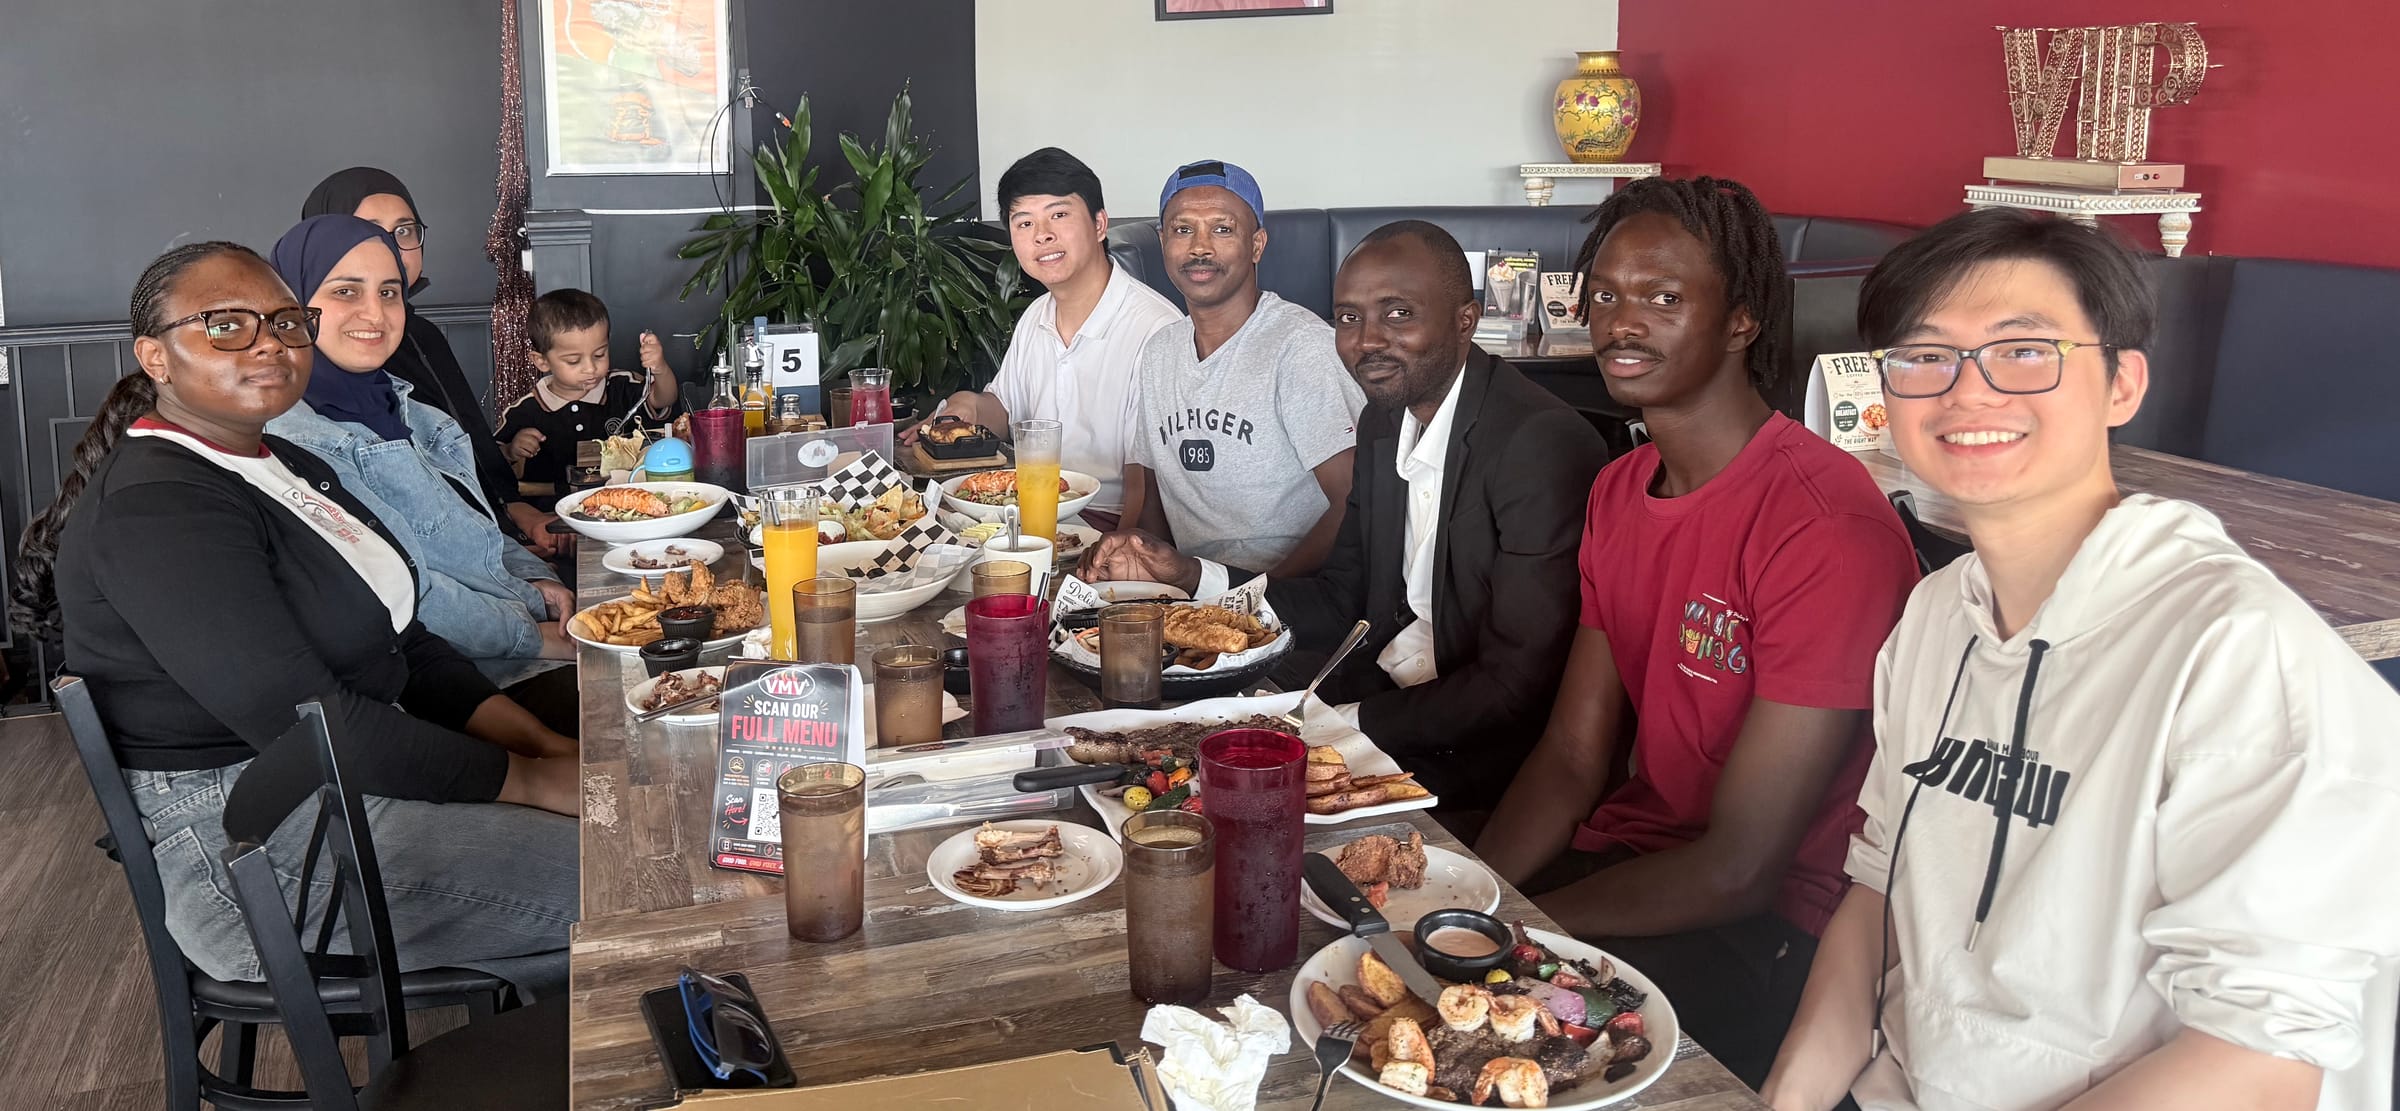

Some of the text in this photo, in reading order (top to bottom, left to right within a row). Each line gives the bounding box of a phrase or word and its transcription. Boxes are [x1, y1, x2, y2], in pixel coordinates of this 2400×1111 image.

[1999, 23, 2207, 164] VIP
[781, 348, 802, 373] 5
[1831, 356, 1870, 375] FREE
[1183, 447, 1210, 464] 1985
[754, 700, 819, 719] SCAN OUR
[731, 715, 838, 748] FULL MENU
[725, 793, 744, 806] Scan
